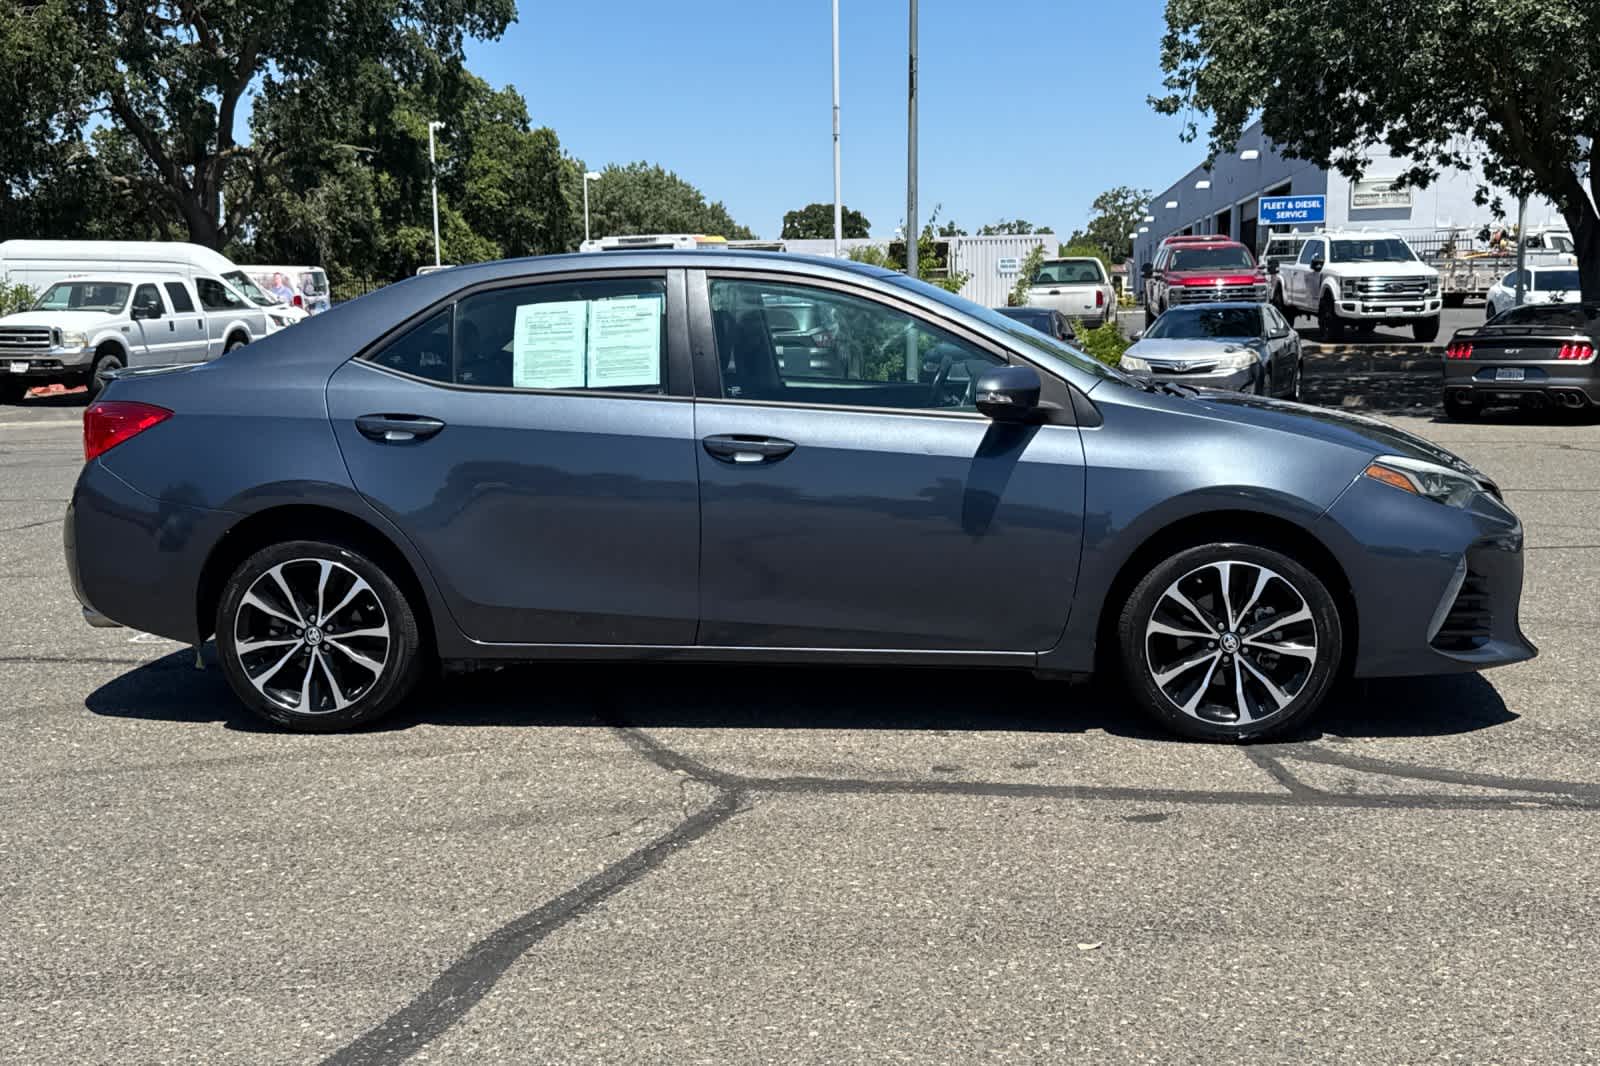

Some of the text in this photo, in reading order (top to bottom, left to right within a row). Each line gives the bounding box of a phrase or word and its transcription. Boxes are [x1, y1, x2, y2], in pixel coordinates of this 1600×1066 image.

[1264, 200, 1321, 210] FLEET & DIESEL
[1276, 210, 1308, 219] SERVICE
